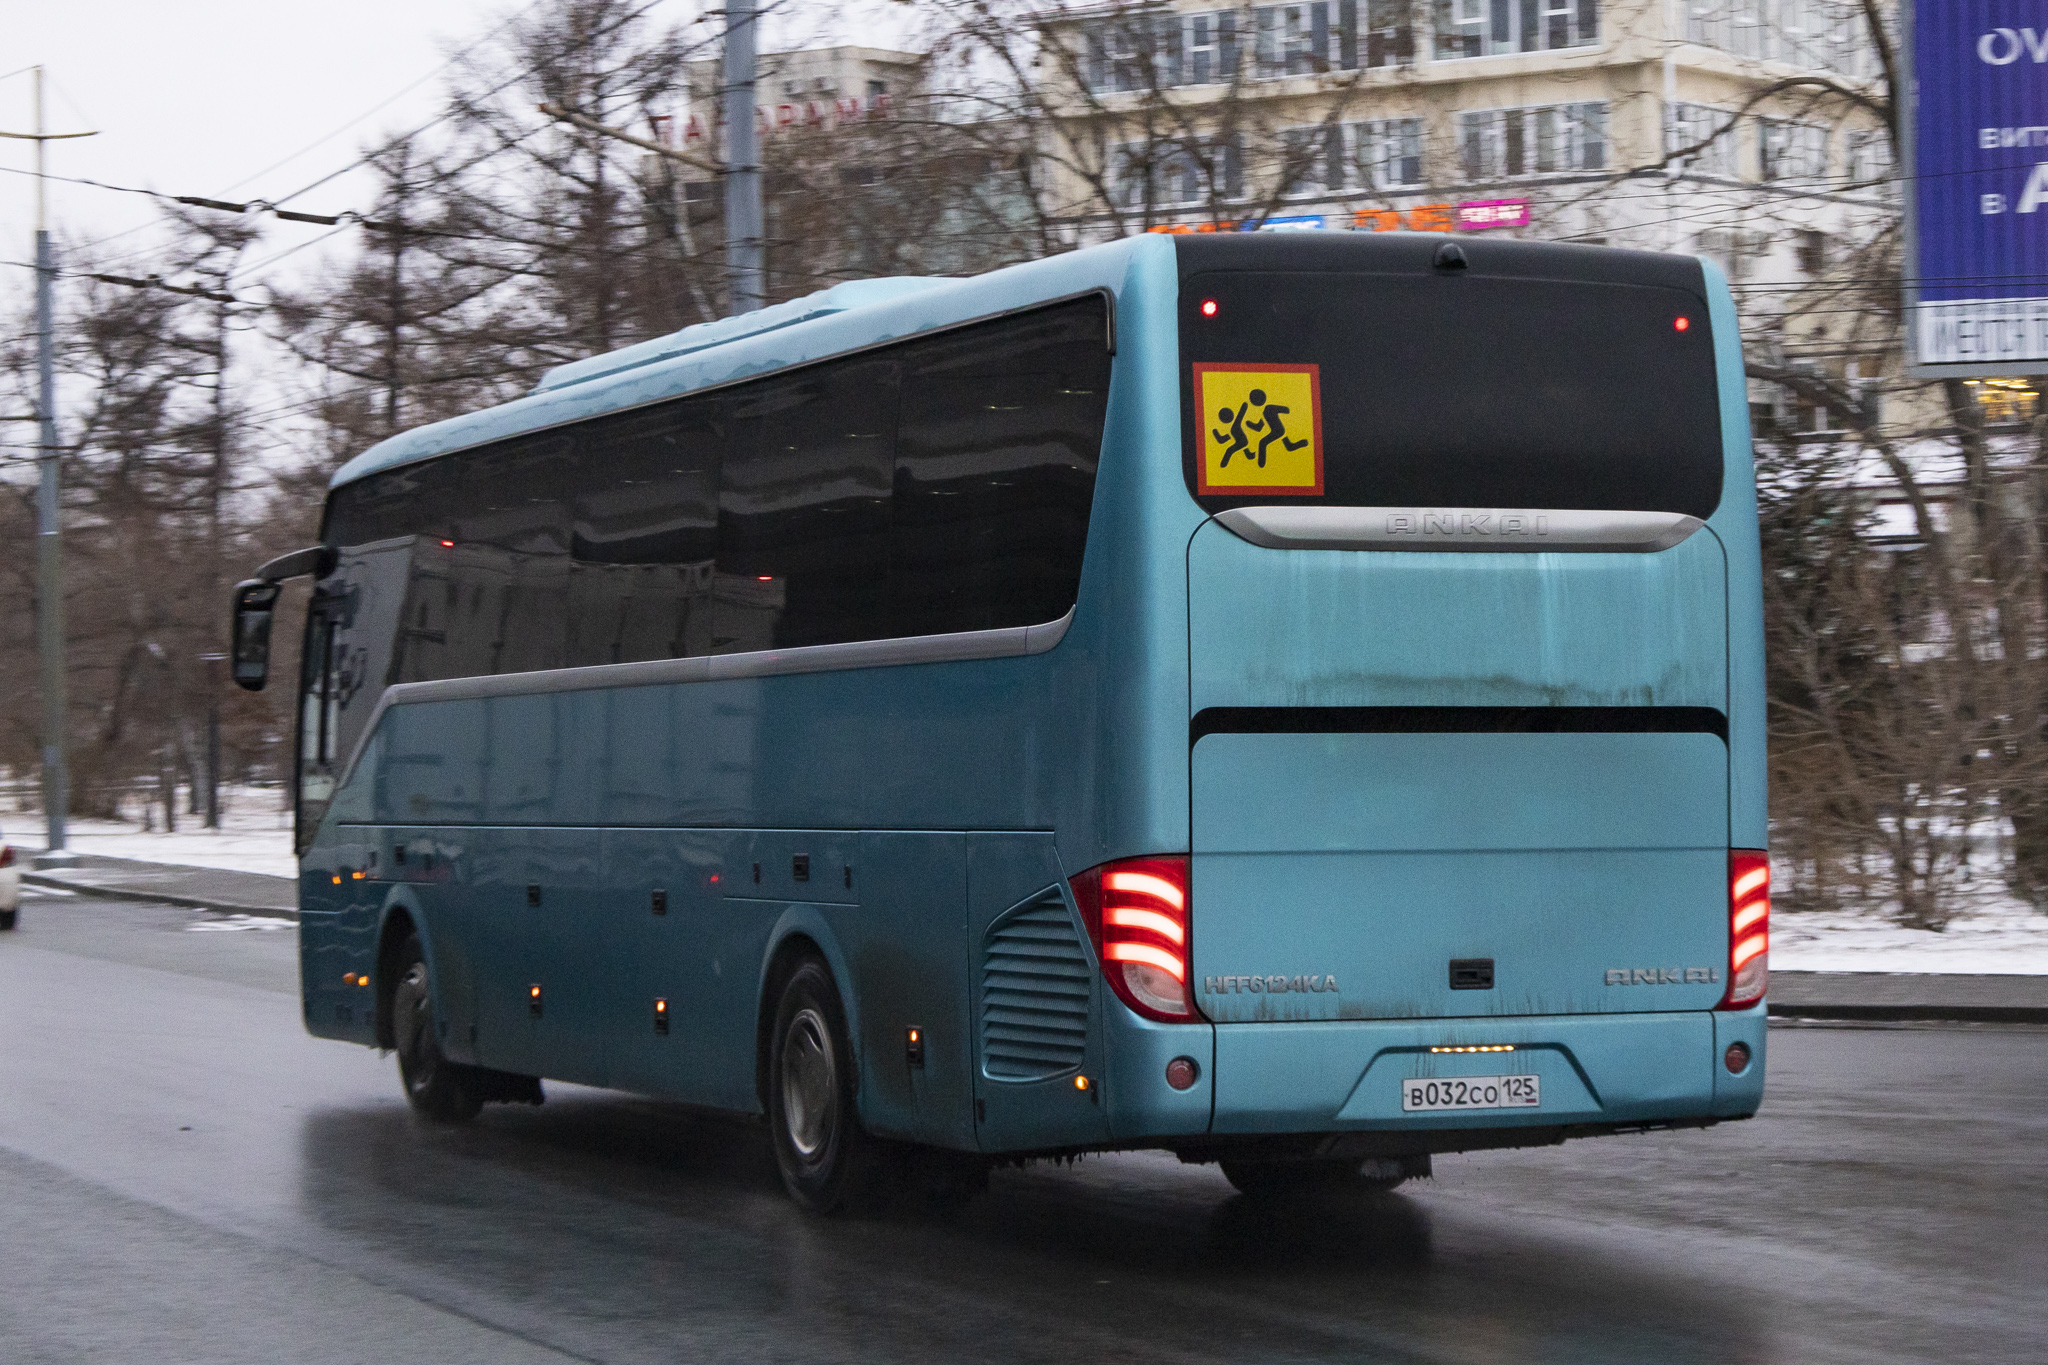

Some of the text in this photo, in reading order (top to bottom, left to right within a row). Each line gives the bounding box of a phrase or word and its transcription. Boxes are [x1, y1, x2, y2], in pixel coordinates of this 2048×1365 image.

[1386, 514, 1548, 536] ANKAI
[1204, 975, 1338, 994] HFF6124KA
[1604, 968, 1718, 986] ANKAI
